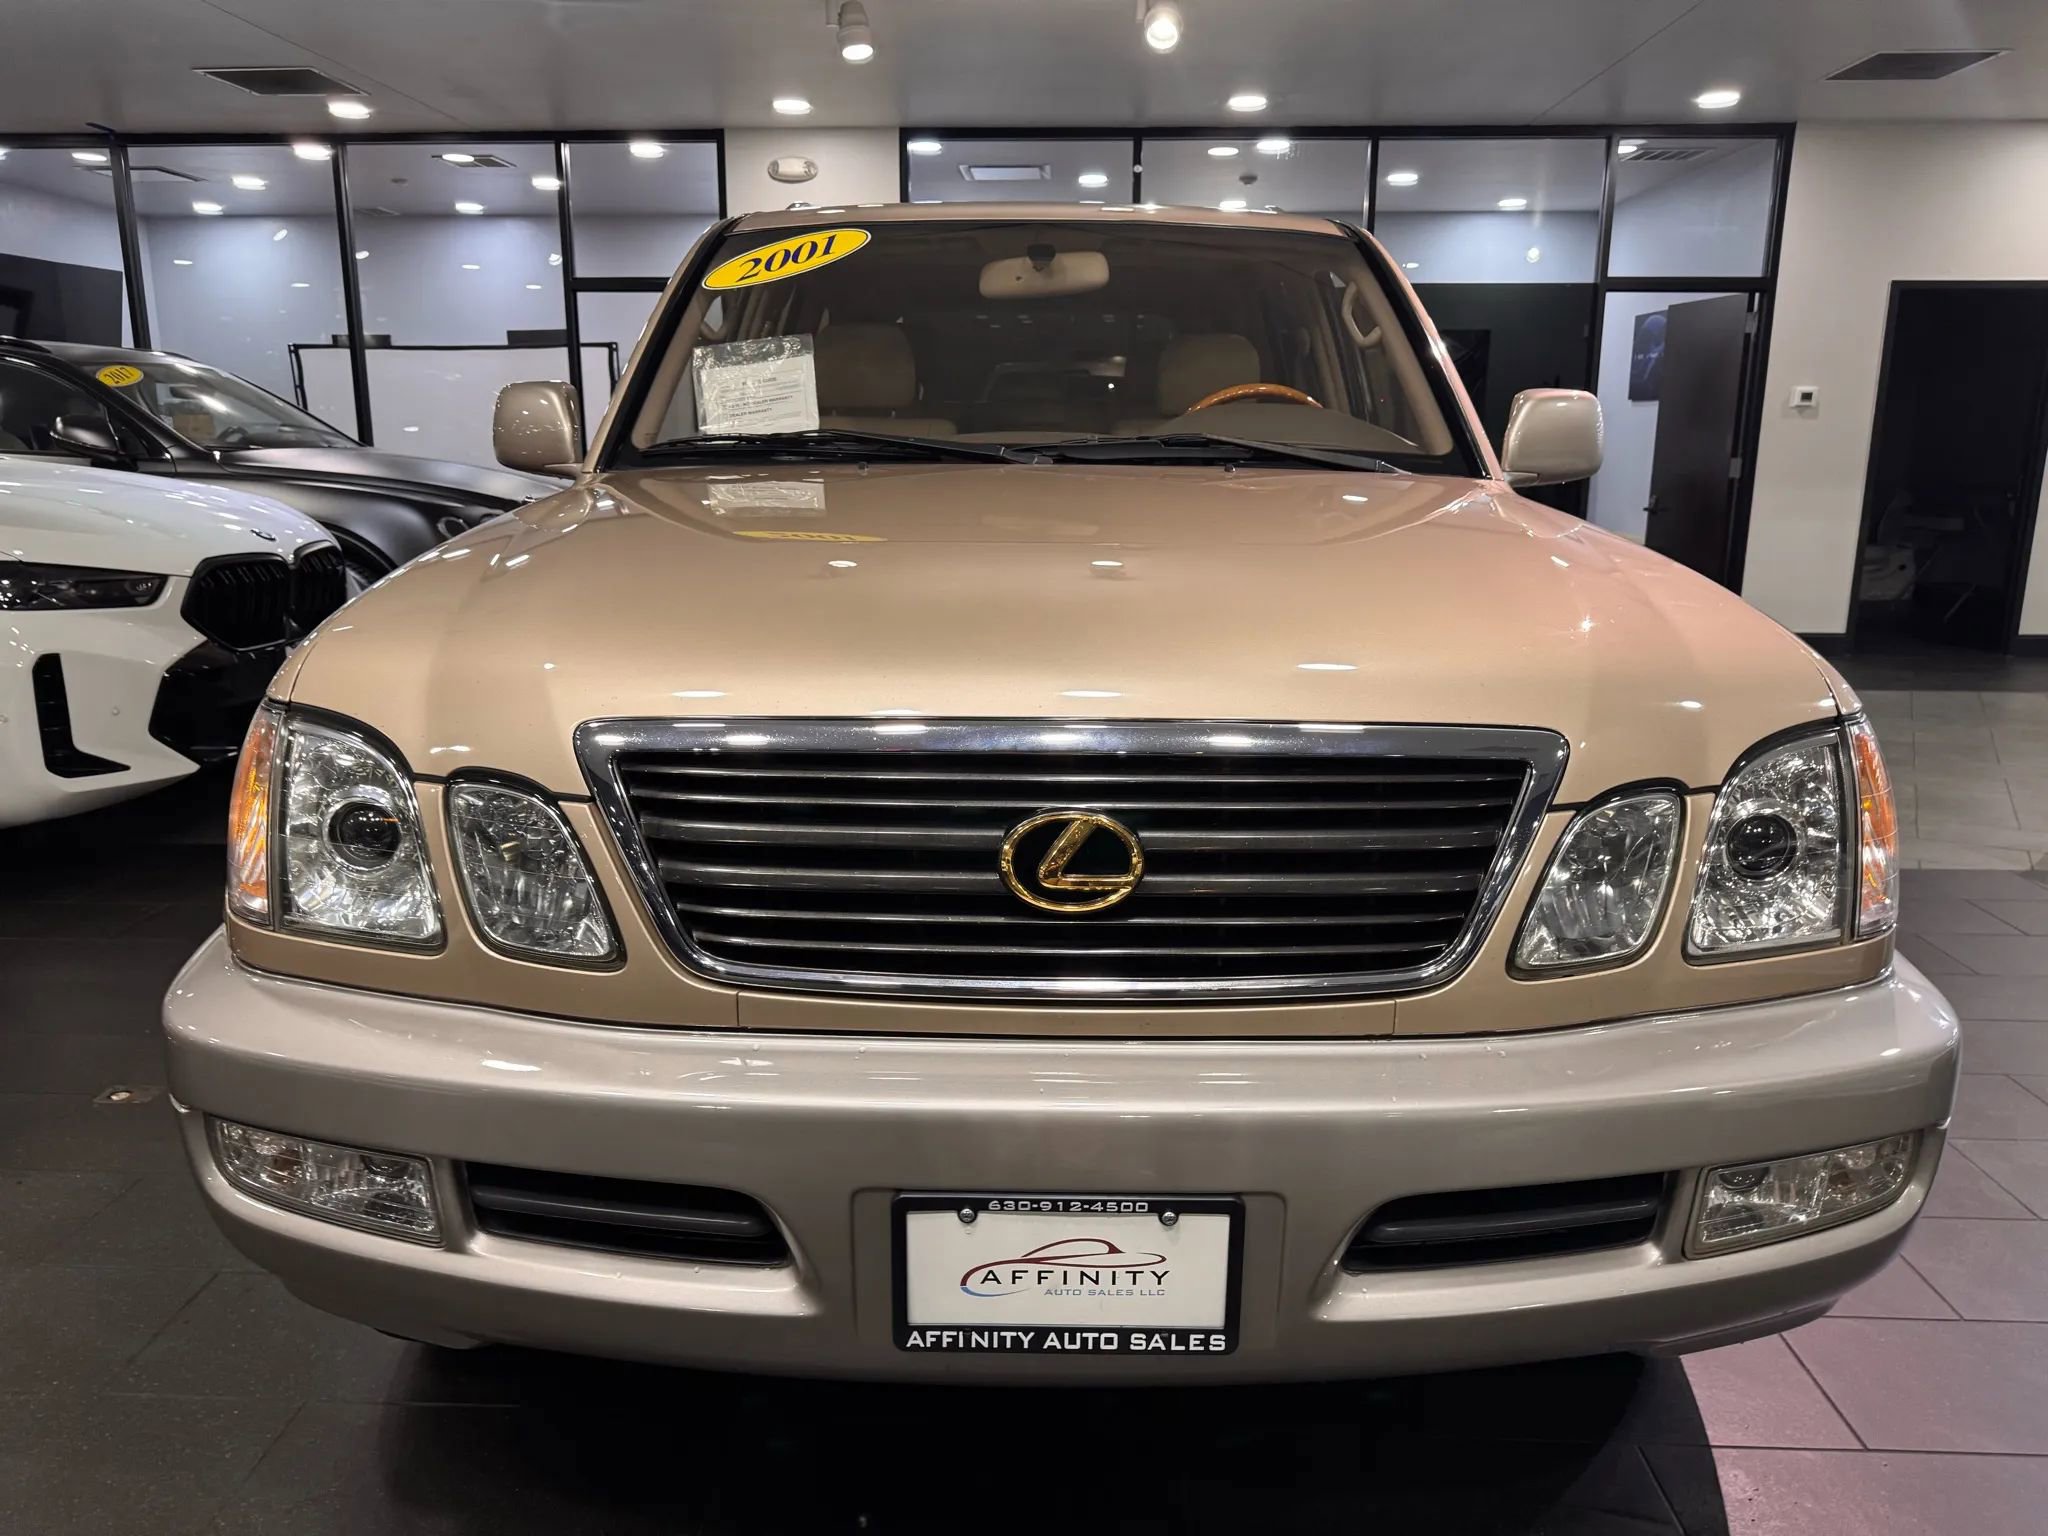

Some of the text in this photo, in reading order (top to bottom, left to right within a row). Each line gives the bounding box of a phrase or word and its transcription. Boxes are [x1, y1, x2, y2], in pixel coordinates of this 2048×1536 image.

[736, 234, 837, 283] 2001
[988, 1200, 1149, 1213] 630-912-4500
[980, 1269, 1170, 1286] AFFINITY
[1044, 1288, 1166, 1297] AUTO SALES LLC
[906, 1330, 1226, 1351] AFFINITY AUTO SALES
